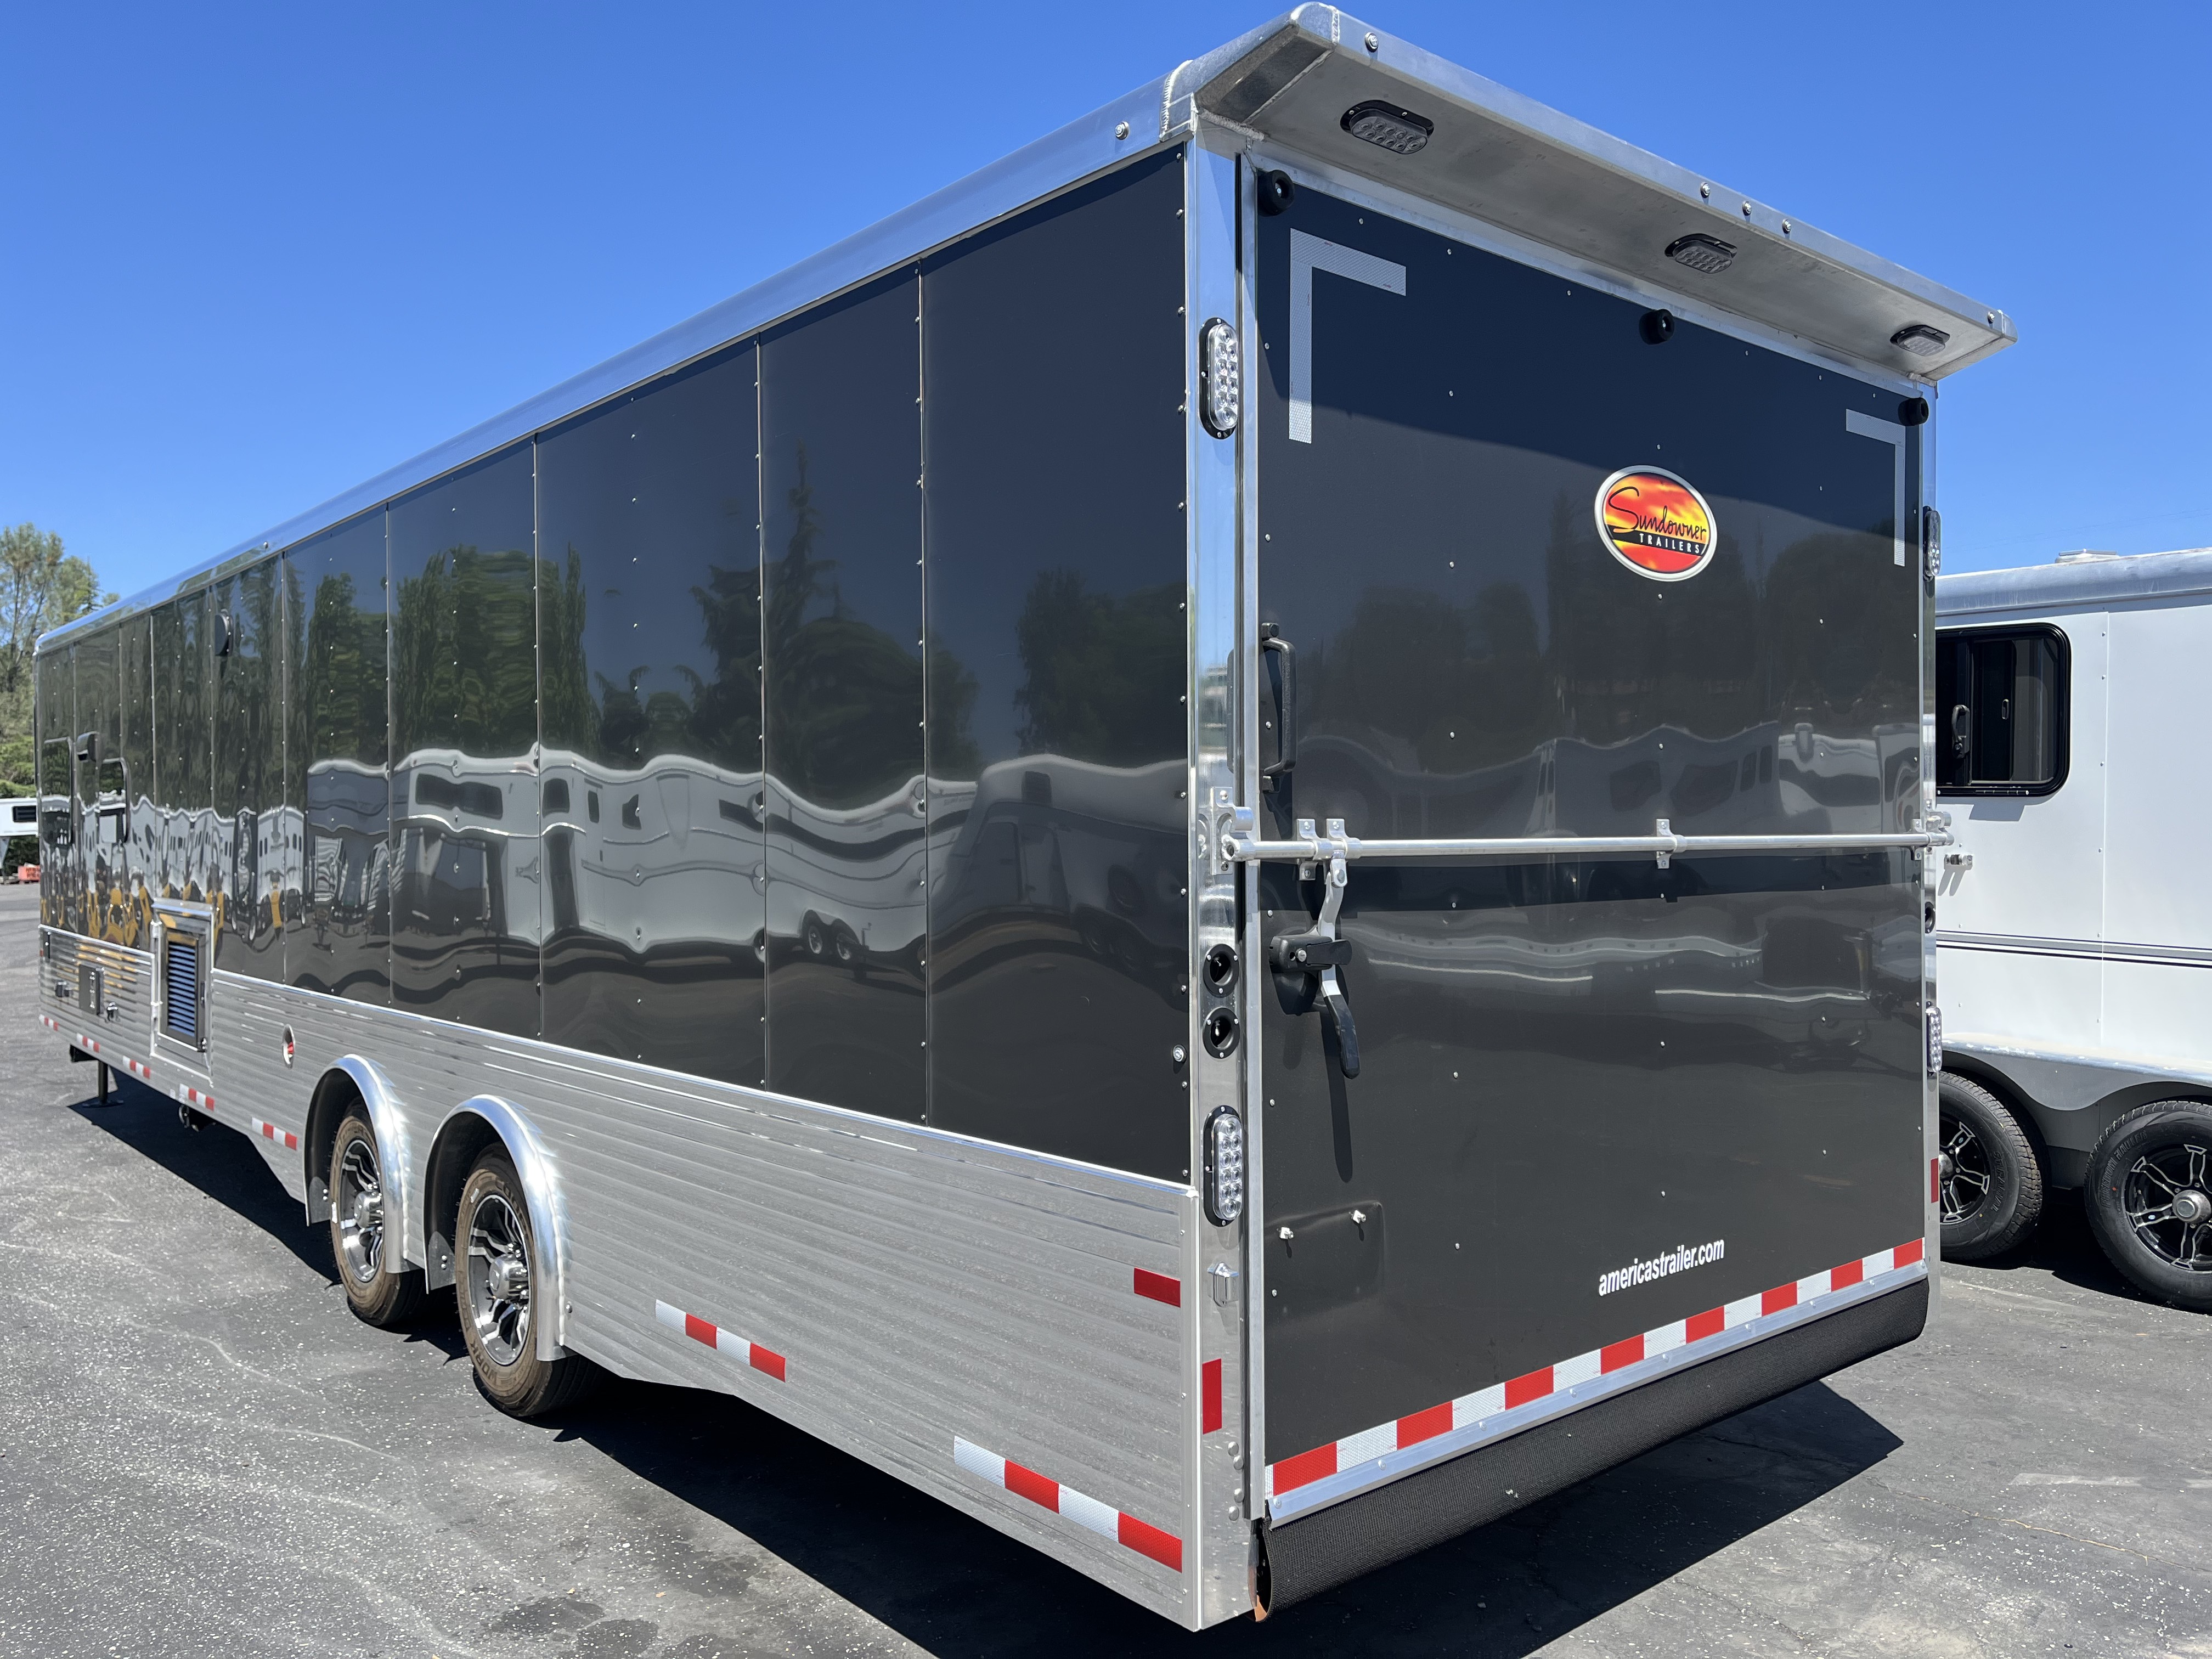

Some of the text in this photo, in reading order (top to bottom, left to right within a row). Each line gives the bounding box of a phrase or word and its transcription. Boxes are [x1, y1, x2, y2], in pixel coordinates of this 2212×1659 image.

[1608, 486, 1707, 540] Sundowner
[1639, 533, 1700, 554] TRAILERS
[1599, 1239, 1724, 1296] americastrailer.com
